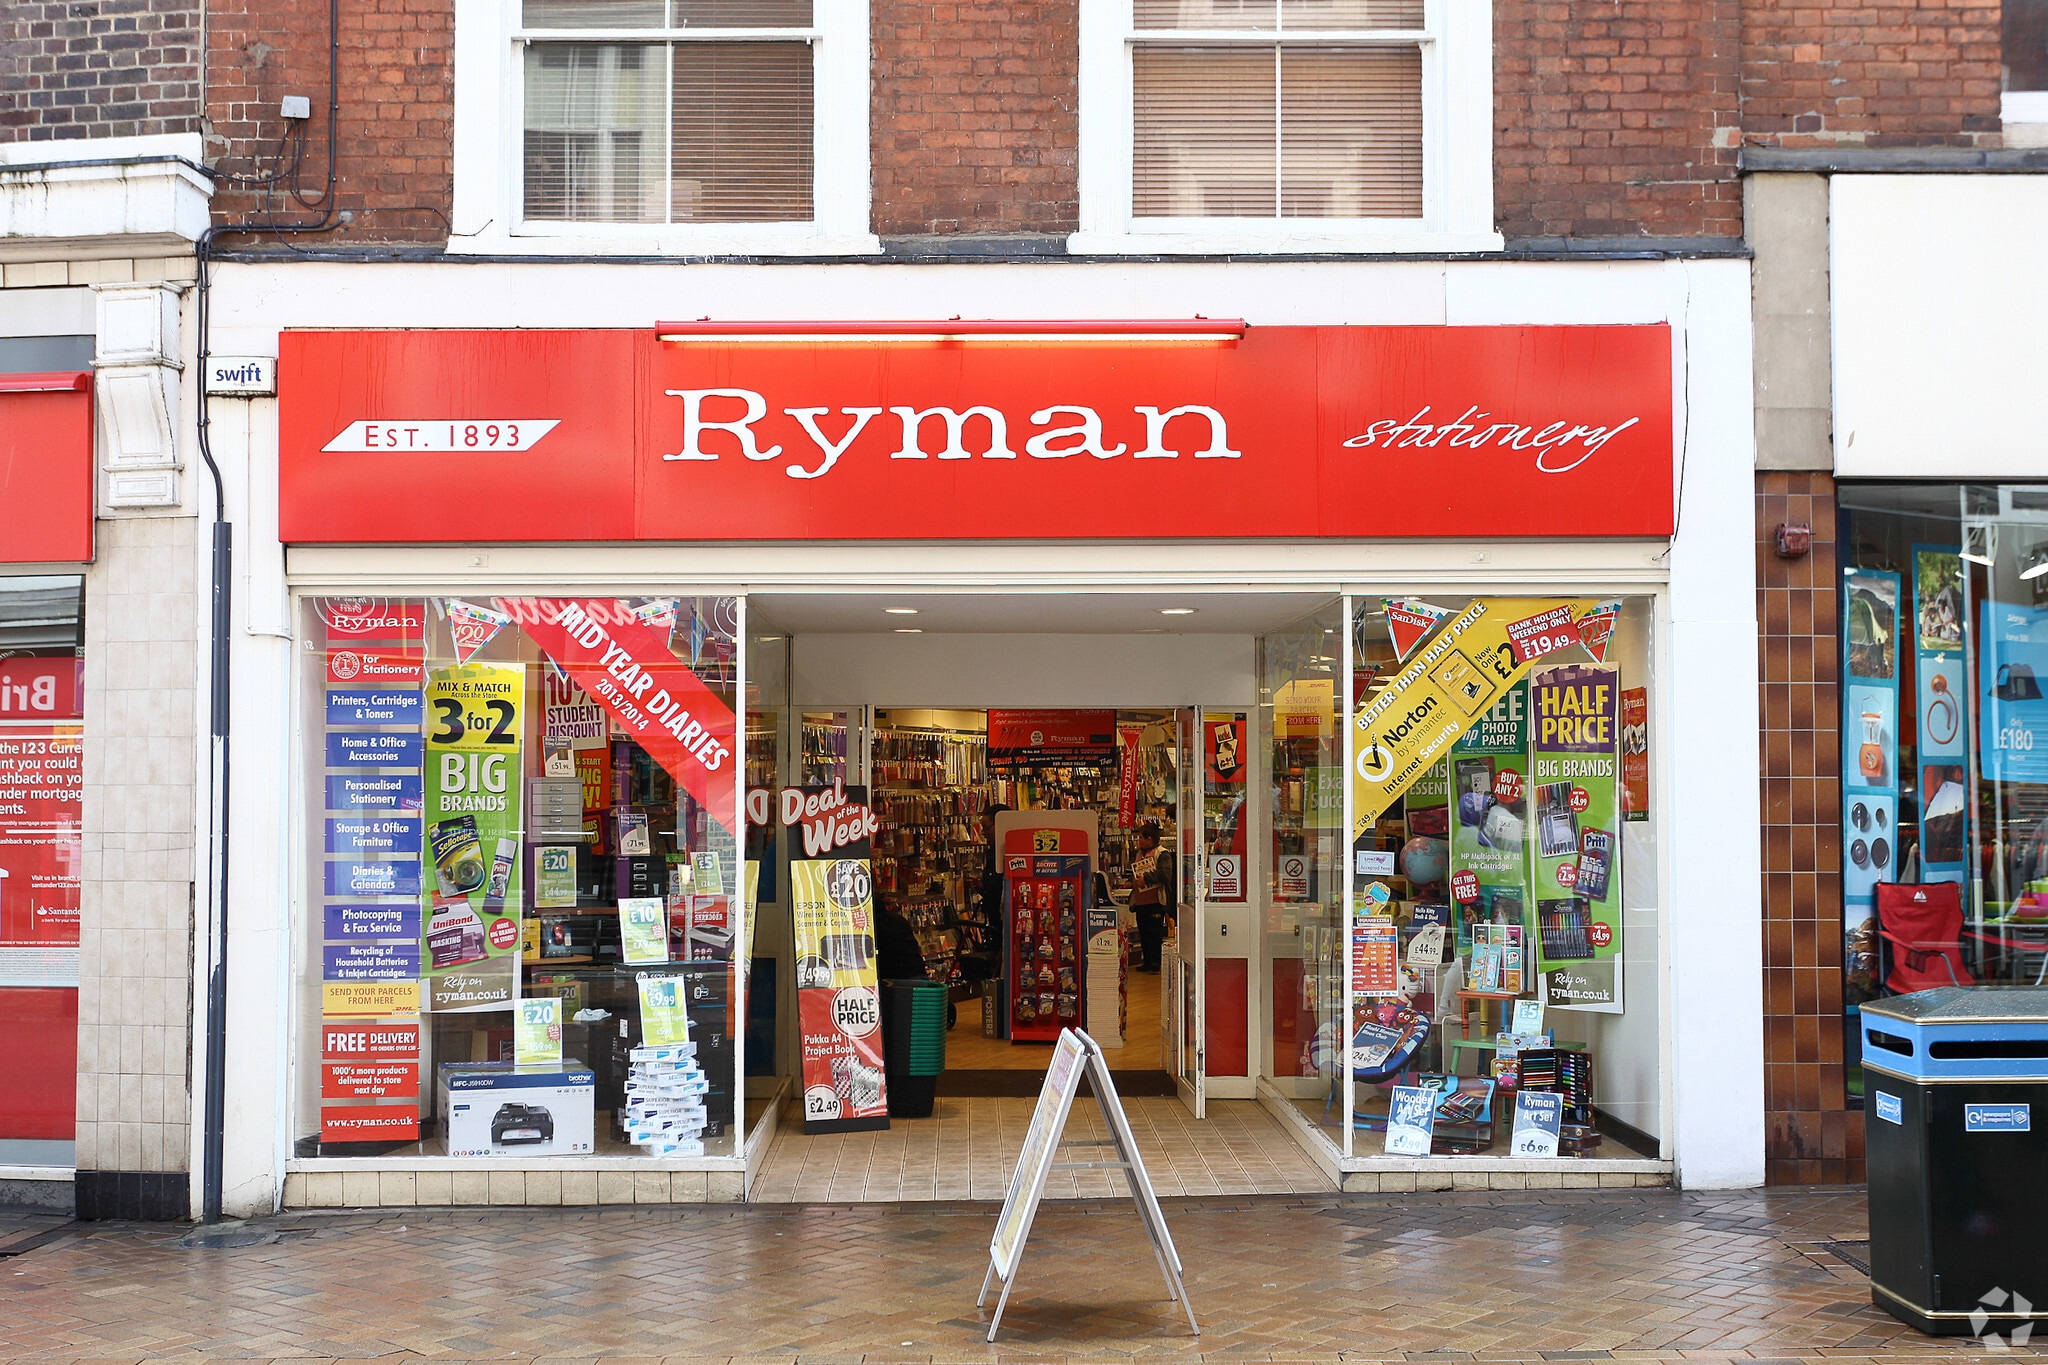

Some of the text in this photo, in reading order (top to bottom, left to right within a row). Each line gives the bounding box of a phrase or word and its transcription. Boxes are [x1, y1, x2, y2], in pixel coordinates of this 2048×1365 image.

[216, 362, 262, 386] swift
[450, 425, 519, 447] 1893
[663, 388, 1242, 479] Ryman
[1341, 404, 1640, 473] stationery
[333, 616, 418, 630] Ryman
[1391, 612, 1430, 628] SanDisk
[1508, 607, 1570, 633] BANK HOLIDAY
[1511, 614, 1571, 641] WEEKEND ONLY
[1524, 634, 1569, 659] £19.49
[363, 654, 379, 663] for
[1474, 646, 1492, 662] Now
[1482, 652, 1499, 669] Only
[363, 665, 420, 676] Stationery
[1357, 602, 1488, 730] BETTER THAN HALF PRICE
[437, 682, 511, 692] MIX & MATCH
[555, 601, 729, 771] MID YEAR DIARIES
[332, 695, 418, 707] Printers, Cartridges
[595, 678, 651, 731] 2013/2014
[1541, 685, 1609, 716] HALF
[356, 709, 394, 718] & Toners
[548, 705, 601, 724] STUDENT
[431, 698, 465, 744] 3
[466, 712, 492, 730] for
[1382, 696, 1438, 748] Norton
[1482, 722, 1517, 733] PHOTO
[548, 722, 602, 738] DISCOUNT
[1396, 708, 1447, 757] by Symantec
[1541, 717, 1610, 744] PRICE
[342, 737, 407, 747] Home & Office
[1482, 735, 1516, 746] PAPER
[2000, 728, 2033, 751] £180
[0, 742, 84, 754] the 123 Curre
[349, 751, 399, 761] Accessories
[1382, 720, 1460, 795] Internet Security
[17, 760, 40, 772] you
[44, 757, 78, 769] could
[1538, 759, 1614, 777] BIG BRANDS
[440, 754, 507, 793] BIG
[1500, 772, 1518, 784] BUY
[345, 780, 401, 790] Personalised
[1495, 784, 1519, 797] ANY 2
[350, 794, 396, 805] Stationery
[440, 796, 507, 812] BRANDS
[781, 777, 846, 825] Deal
[1570, 796, 1587, 806] £4.99
[837, 805, 859, 820] of the
[336, 822, 409, 835] Storage & Office
[804, 807, 878, 857] Week
[352, 836, 393, 846] Furniture
[438, 832, 472, 855] Sellotape
[1586, 835, 1606, 848] Pritt
[545, 855, 567, 870] £20
[1011, 860, 1024, 868] Pritt
[1480, 862, 1513, 871] Cartridges
[352, 866, 394, 875] Diaries &
[1558, 871, 1576, 882] £2.99
[351, 879, 395, 889] Calendars
[1453, 874, 1475, 885] GET THIS
[1455, 884, 1478, 900] FREE
[342, 909, 402, 921] Photocopying
[630, 906, 655, 923] £10
[343, 923, 401, 933] & Fax Service
[433, 915, 473, 929] UniBond
[430, 936, 461, 948] MASKING
[1592, 930, 1610, 941] £4.99
[350, 946, 393, 956] Recycling of
[1415, 944, 1436, 955] £44.99
[336, 957, 408, 966] Household Batteries
[346, 969, 366, 979] Inkjet
[368, 969, 406, 978] Cartridges
[443, 974, 467, 992] Rely
[1555, 973, 1586, 989] Rely on
[330, 988, 351, 996] SEND
[378, 987, 412, 995] PARCELS
[435, 988, 507, 1003] ryman.co.uk
[1551, 988, 1609, 1000] ryman.co.uk
[837, 999, 874, 1012] HALF
[525, 1006, 554, 1024] £20
[838, 1012, 875, 1025] PRICE
[1521, 1006, 1538, 1019] £5
[327, 1033, 416, 1052] FREE DELIVERY
[804, 1033, 842, 1045] Pukka A4
[805, 1044, 856, 1057] Project Book
[377, 1066, 408, 1076] products
[338, 1076, 372, 1085] delivered
[374, 1076, 381, 1084] to
[568, 1074, 592, 1082] brother
[354, 1086, 385, 1095] next day
[1395, 1091, 1434, 1105] Wooden
[1524, 1096, 1555, 1108] Ryman
[810, 1098, 838, 1113] £2.49
[327, 1116, 413, 1128] www.ryman.co.uk
[1523, 1110, 1554, 1122] Art Set
[1521, 1140, 1549, 1153] £6.99
